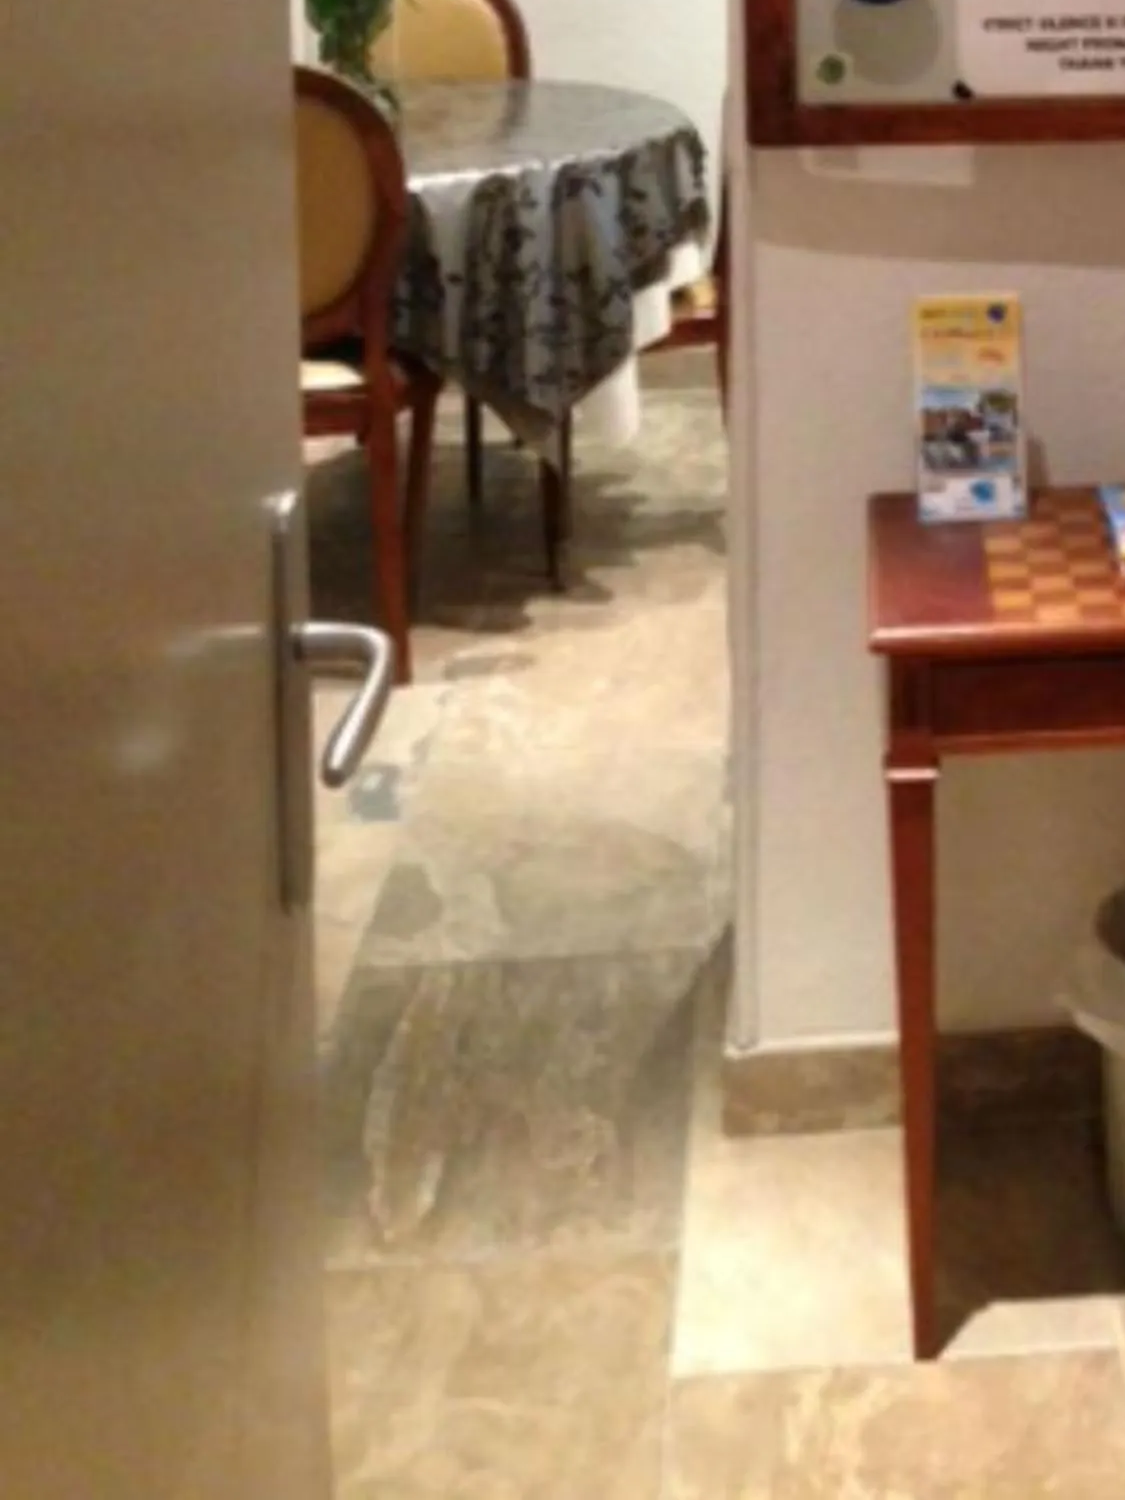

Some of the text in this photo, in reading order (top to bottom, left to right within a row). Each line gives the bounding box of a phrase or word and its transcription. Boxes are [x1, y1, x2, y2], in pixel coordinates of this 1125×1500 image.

[983, 17, 1031, 32] STRICT
[1039, 16, 1102, 30] SILENCE
[1026, 38, 1078, 51] NIGHT
[1058, 57, 1115, 71] THANK
